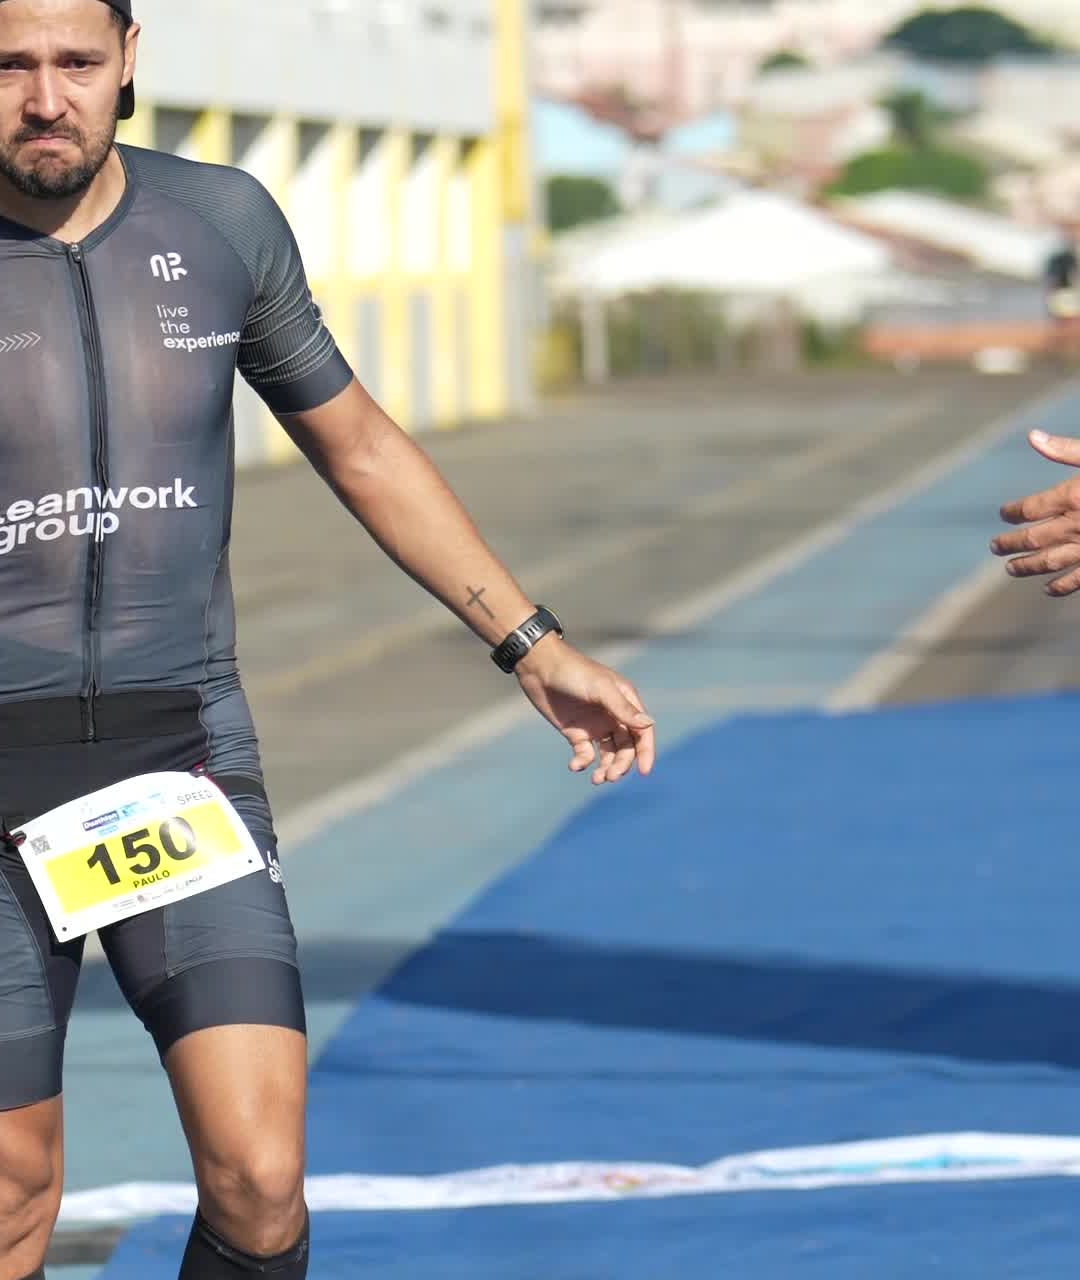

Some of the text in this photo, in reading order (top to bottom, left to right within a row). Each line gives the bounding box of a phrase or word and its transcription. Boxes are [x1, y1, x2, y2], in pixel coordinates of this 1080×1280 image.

[156, 305, 189, 319] live
[160, 320, 190, 335] the
[87, 816, 196, 885] 150
[133, 870, 170, 888] PAULO
